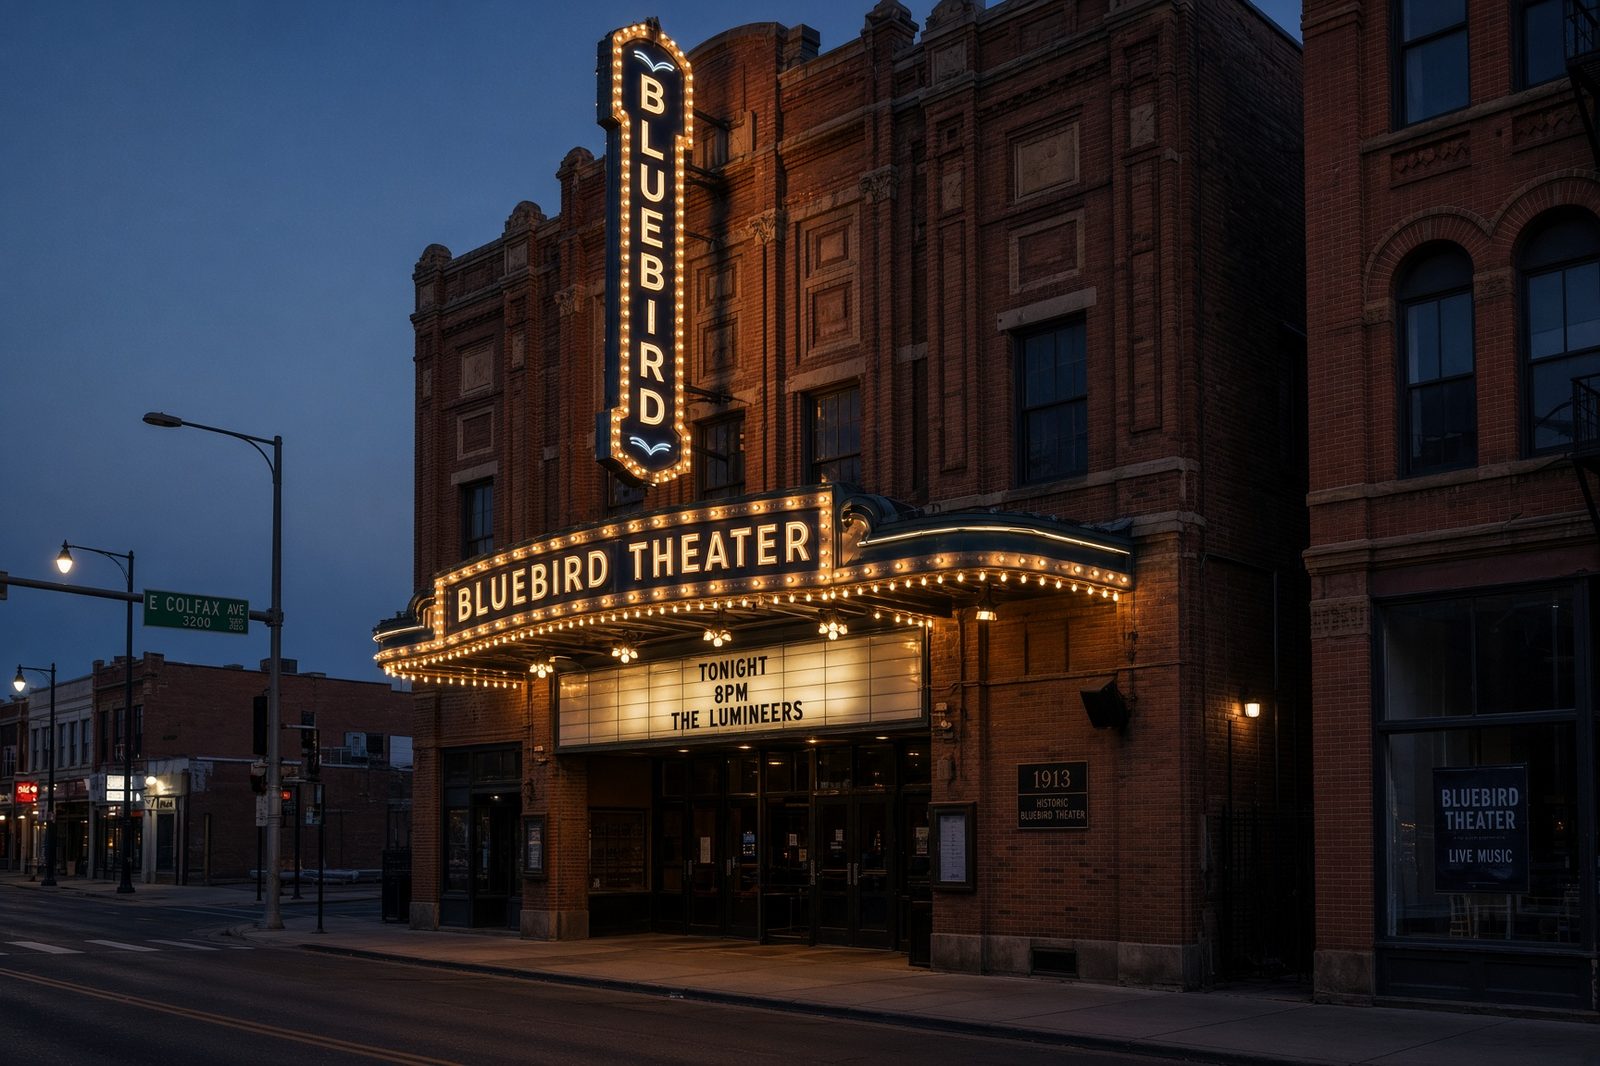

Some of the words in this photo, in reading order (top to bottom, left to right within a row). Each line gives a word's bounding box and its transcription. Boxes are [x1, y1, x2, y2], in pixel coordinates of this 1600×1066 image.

[640, 73, 666, 426] BLUEBIRD
[457, 549, 609, 623] BLUEBIRD
[628, 520, 811, 581] THEATER
[149, 595, 158, 610] E
[166, 596, 220, 617] COLFAX
[227, 603, 245, 616] AVE
[183, 616, 211, 629] 3200
[699, 656, 768, 682] TONIGHT
[715, 682, 748, 704] 8PM
[671, 710, 700, 731] THE
[709, 700, 804, 728] LUMINEERS
[1033, 769, 1071, 789] 1913
[1036, 798, 1069, 808] HISTORIC
[1441, 787, 1519, 808] BLUEBIRD
[1020, 811, 1053, 820] BLUEBIRD
[1055, 809, 1086, 820] THEATER
[1444, 810, 1517, 831] THEATER
[1448, 848, 1473, 864] LIVE
[1477, 848, 1513, 864] MUSIC
